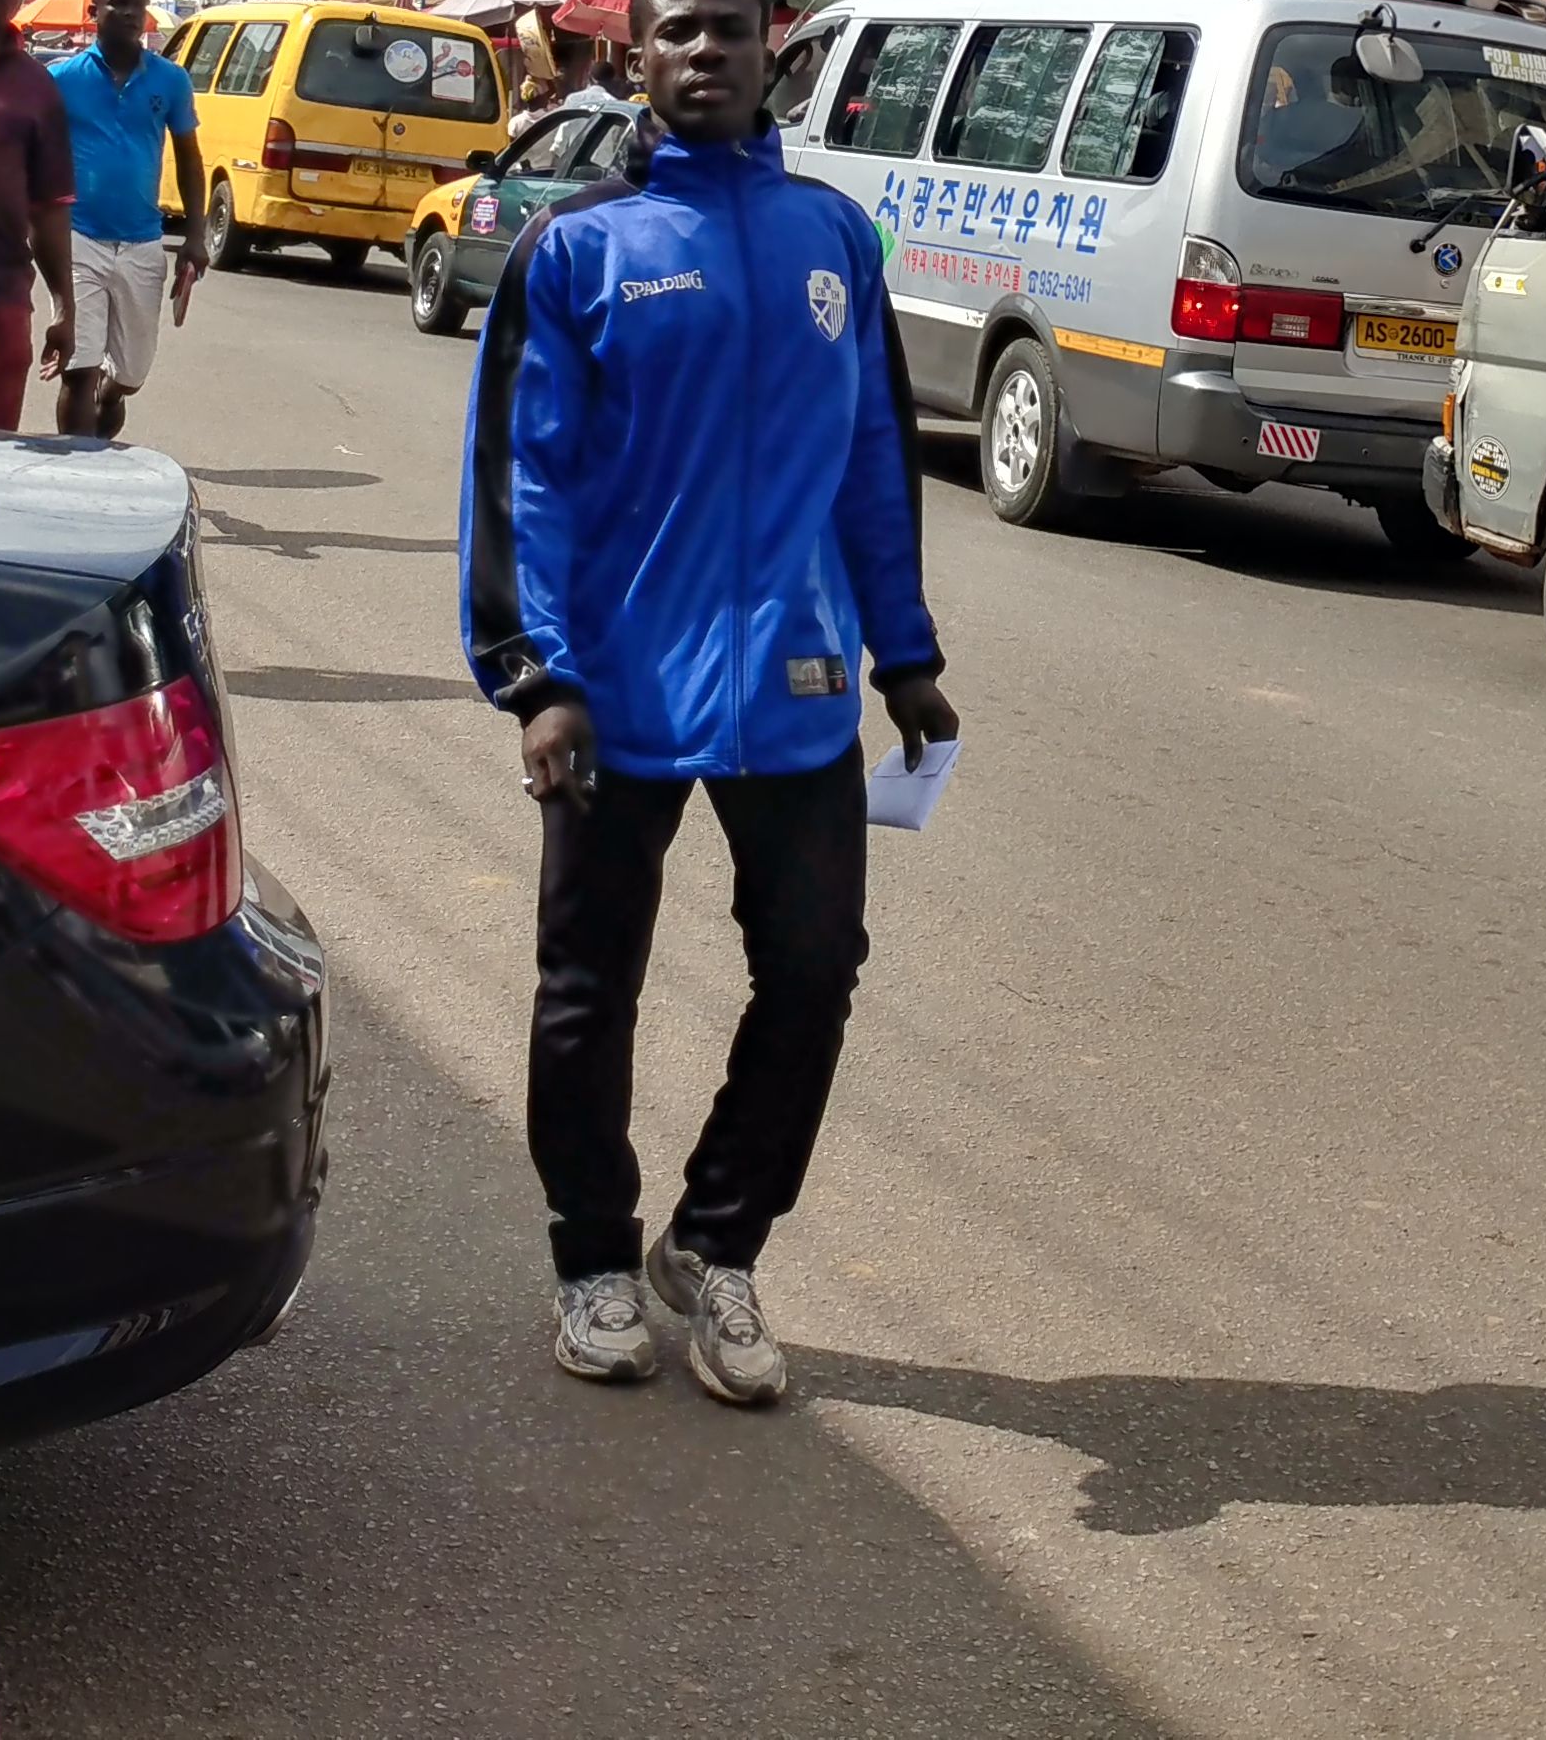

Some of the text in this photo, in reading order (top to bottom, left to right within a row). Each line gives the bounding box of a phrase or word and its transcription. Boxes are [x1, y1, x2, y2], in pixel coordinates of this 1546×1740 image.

[1482, 46, 1512, 65] FOR
[913, 176, 1107, 254] 광주반석유치원
[903, 247, 928, 274] 사랑과
[932, 252, 959, 280] 미래가
[962, 256, 979, 284] 있는
[620, 269, 704, 303] SPALDING
[815, 286, 827, 298] CB
[1039, 269, 1093, 303] 952-6341
[1365, 321, 1387, 343] AS
[1397, 352, 1426, 362] THANK
[1428, 354, 1435, 363] U
